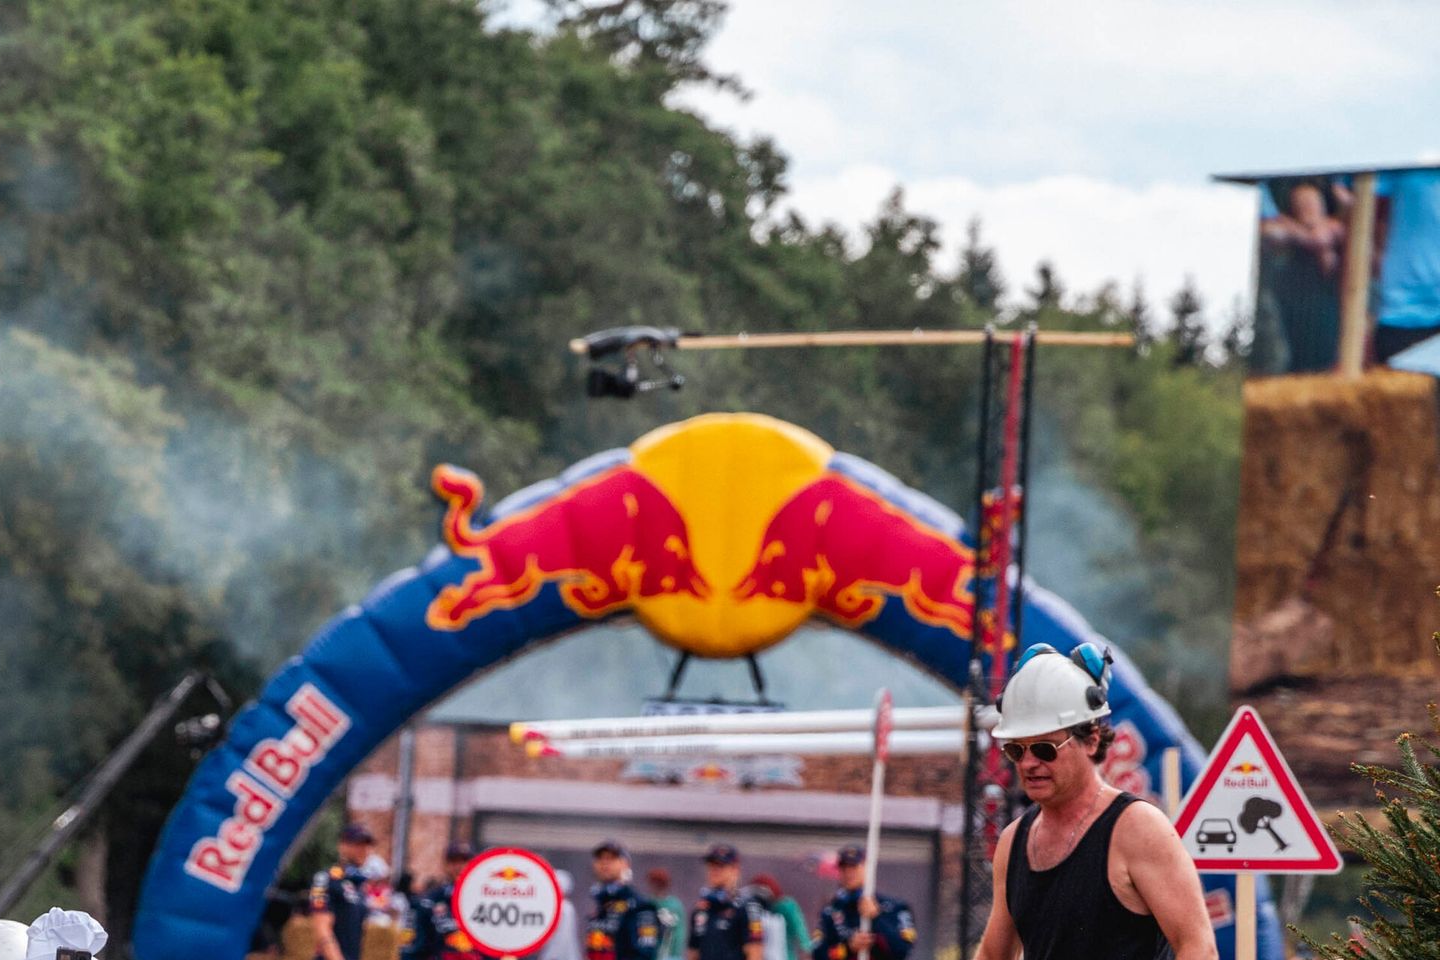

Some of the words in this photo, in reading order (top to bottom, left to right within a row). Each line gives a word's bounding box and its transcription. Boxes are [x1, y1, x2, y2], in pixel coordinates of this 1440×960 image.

[188, 774, 282, 888] Red
[247, 686, 348, 794] Bull
[1224, 778, 1245, 788] Red
[1247, 778, 1268, 788] Bull
[510, 886, 534, 897] Bull
[471, 902, 545, 926] 400m
